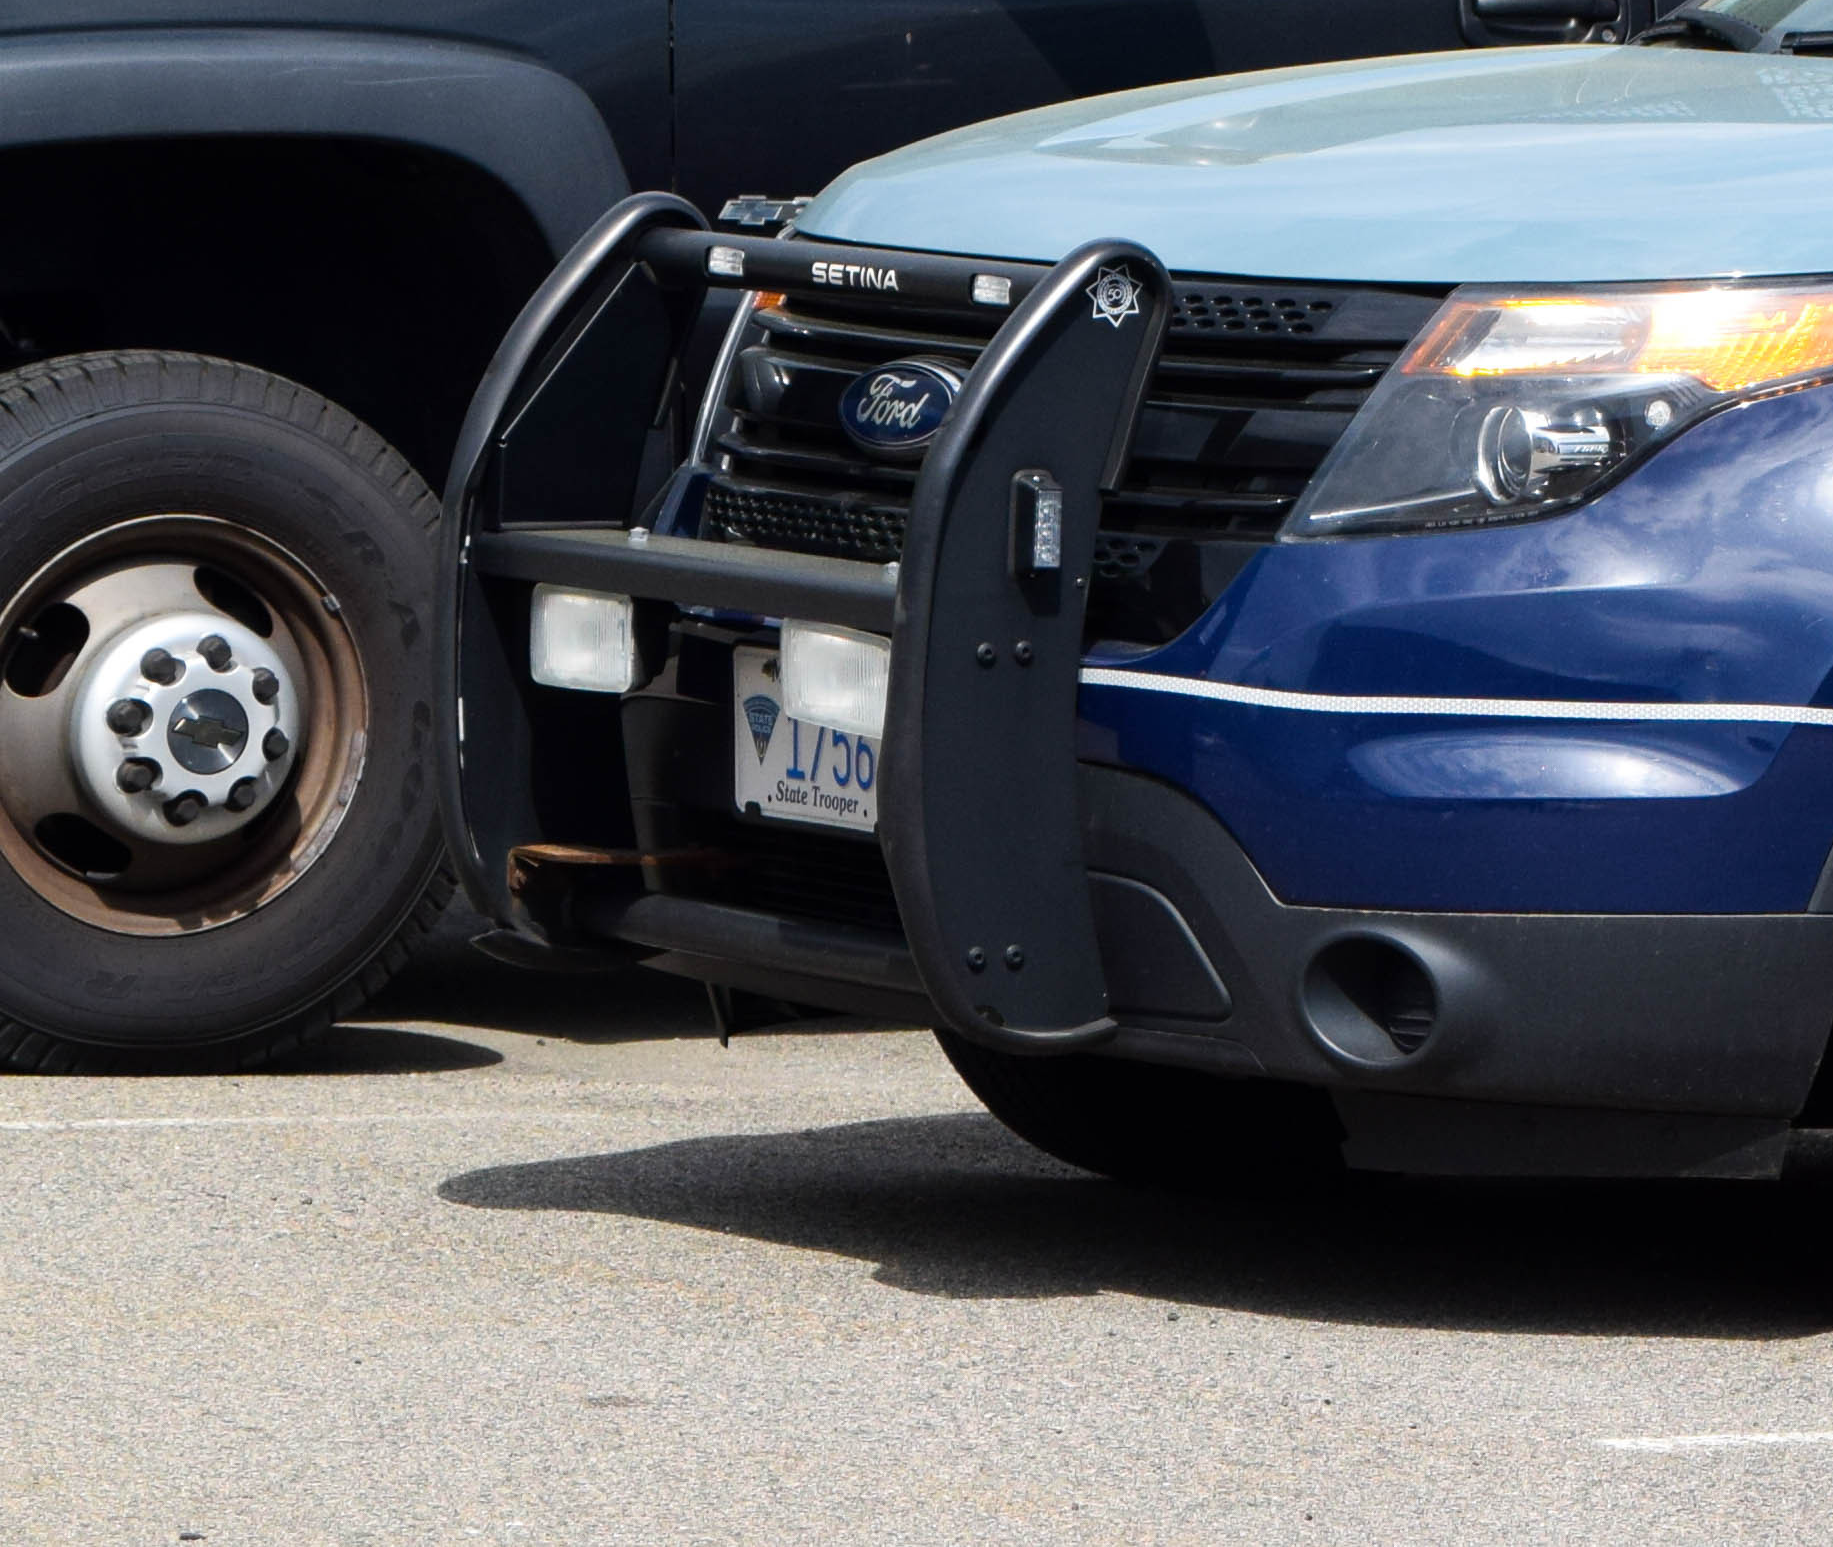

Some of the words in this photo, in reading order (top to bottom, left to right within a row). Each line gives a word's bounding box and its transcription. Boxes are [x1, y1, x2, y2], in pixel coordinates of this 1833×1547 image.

[811, 261, 899, 292] SETINA
[856, 374, 930, 429] Ford
[776, 780, 808, 806] State
[812, 785, 859, 816] Trooper
